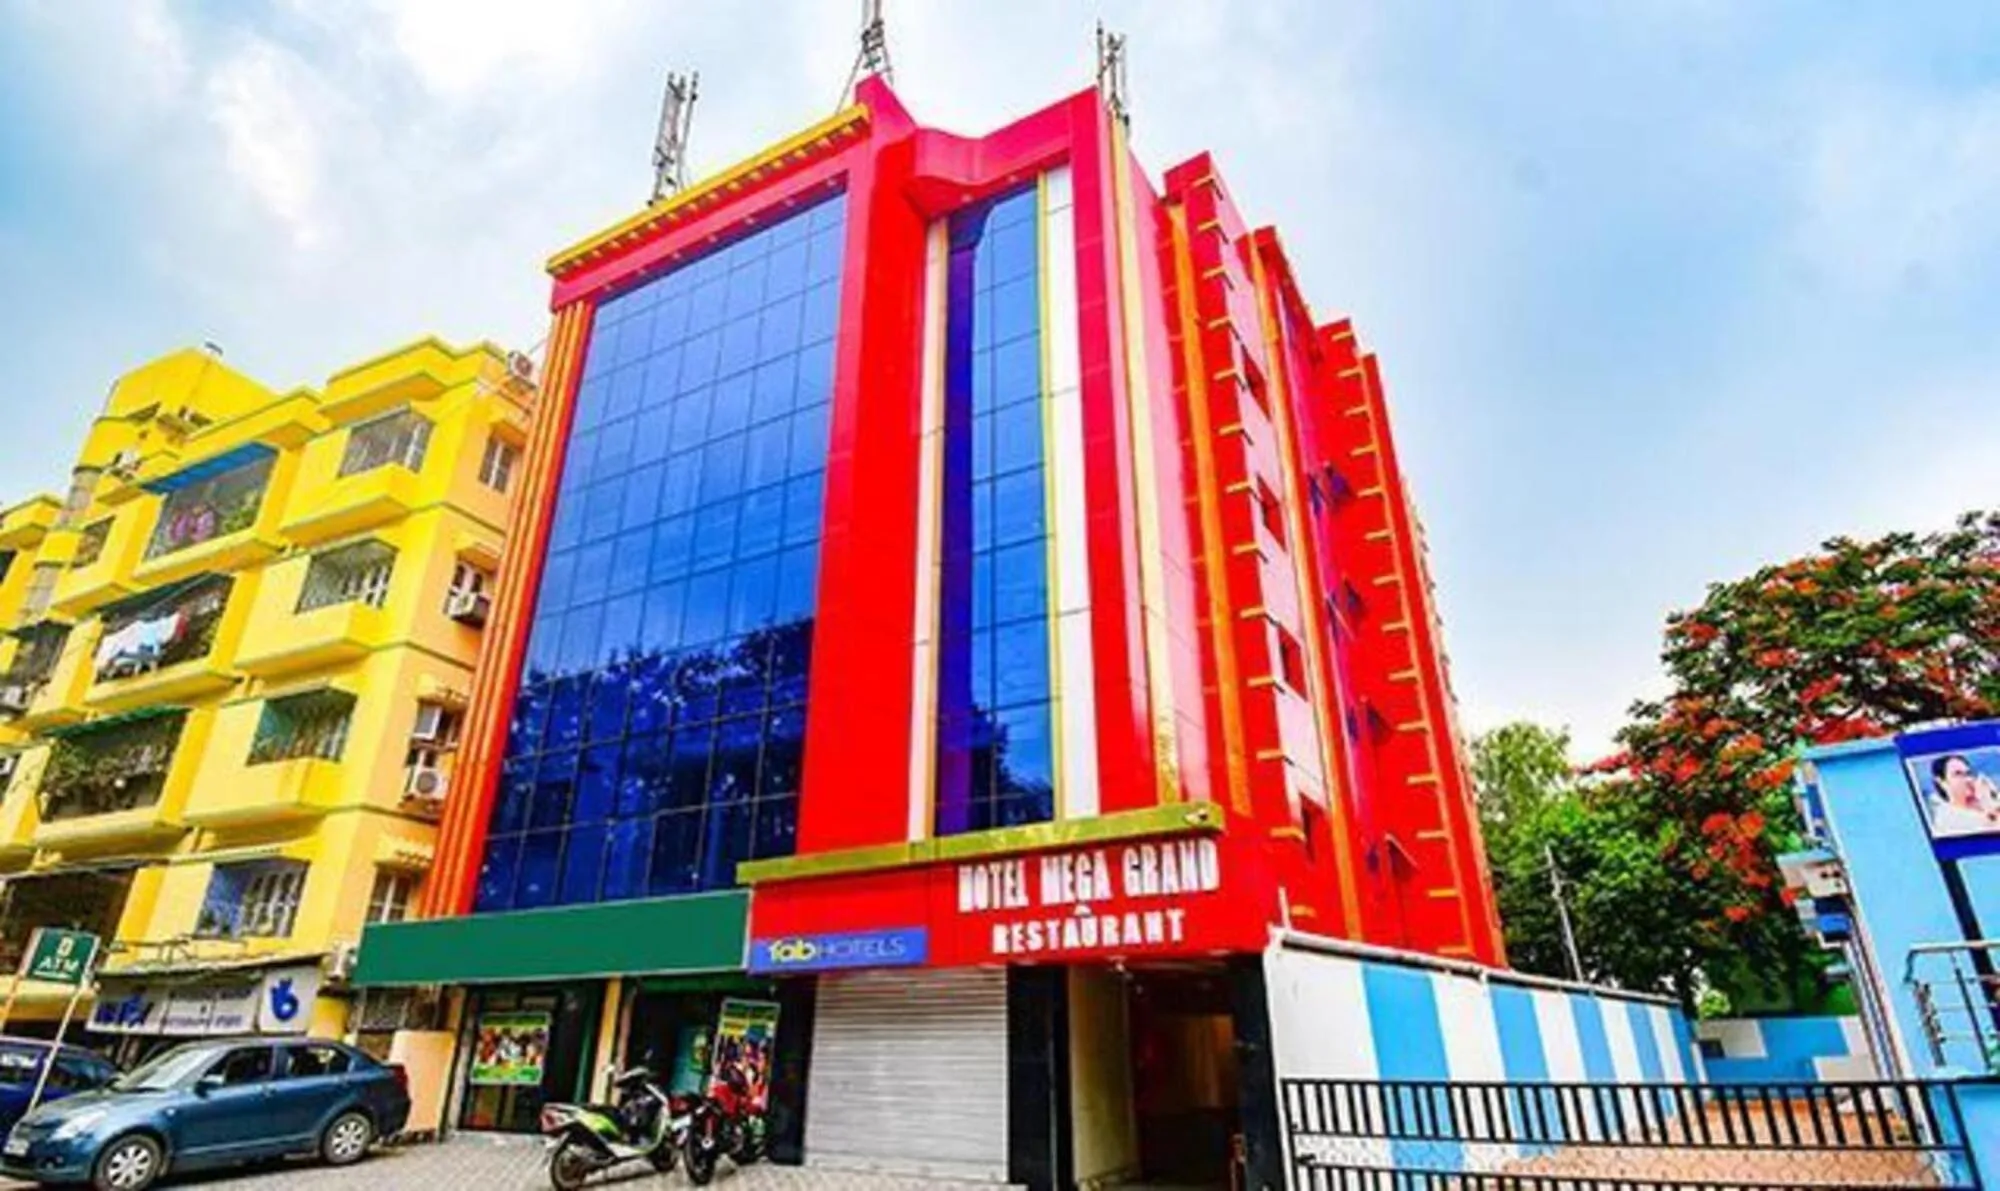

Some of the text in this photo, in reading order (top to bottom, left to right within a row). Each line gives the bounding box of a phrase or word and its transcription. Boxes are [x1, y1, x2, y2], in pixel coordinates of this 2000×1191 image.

[958, 837, 1220, 913] HOTEL MEGA GRAND
[992, 908, 1185, 954] RESTAURANT
